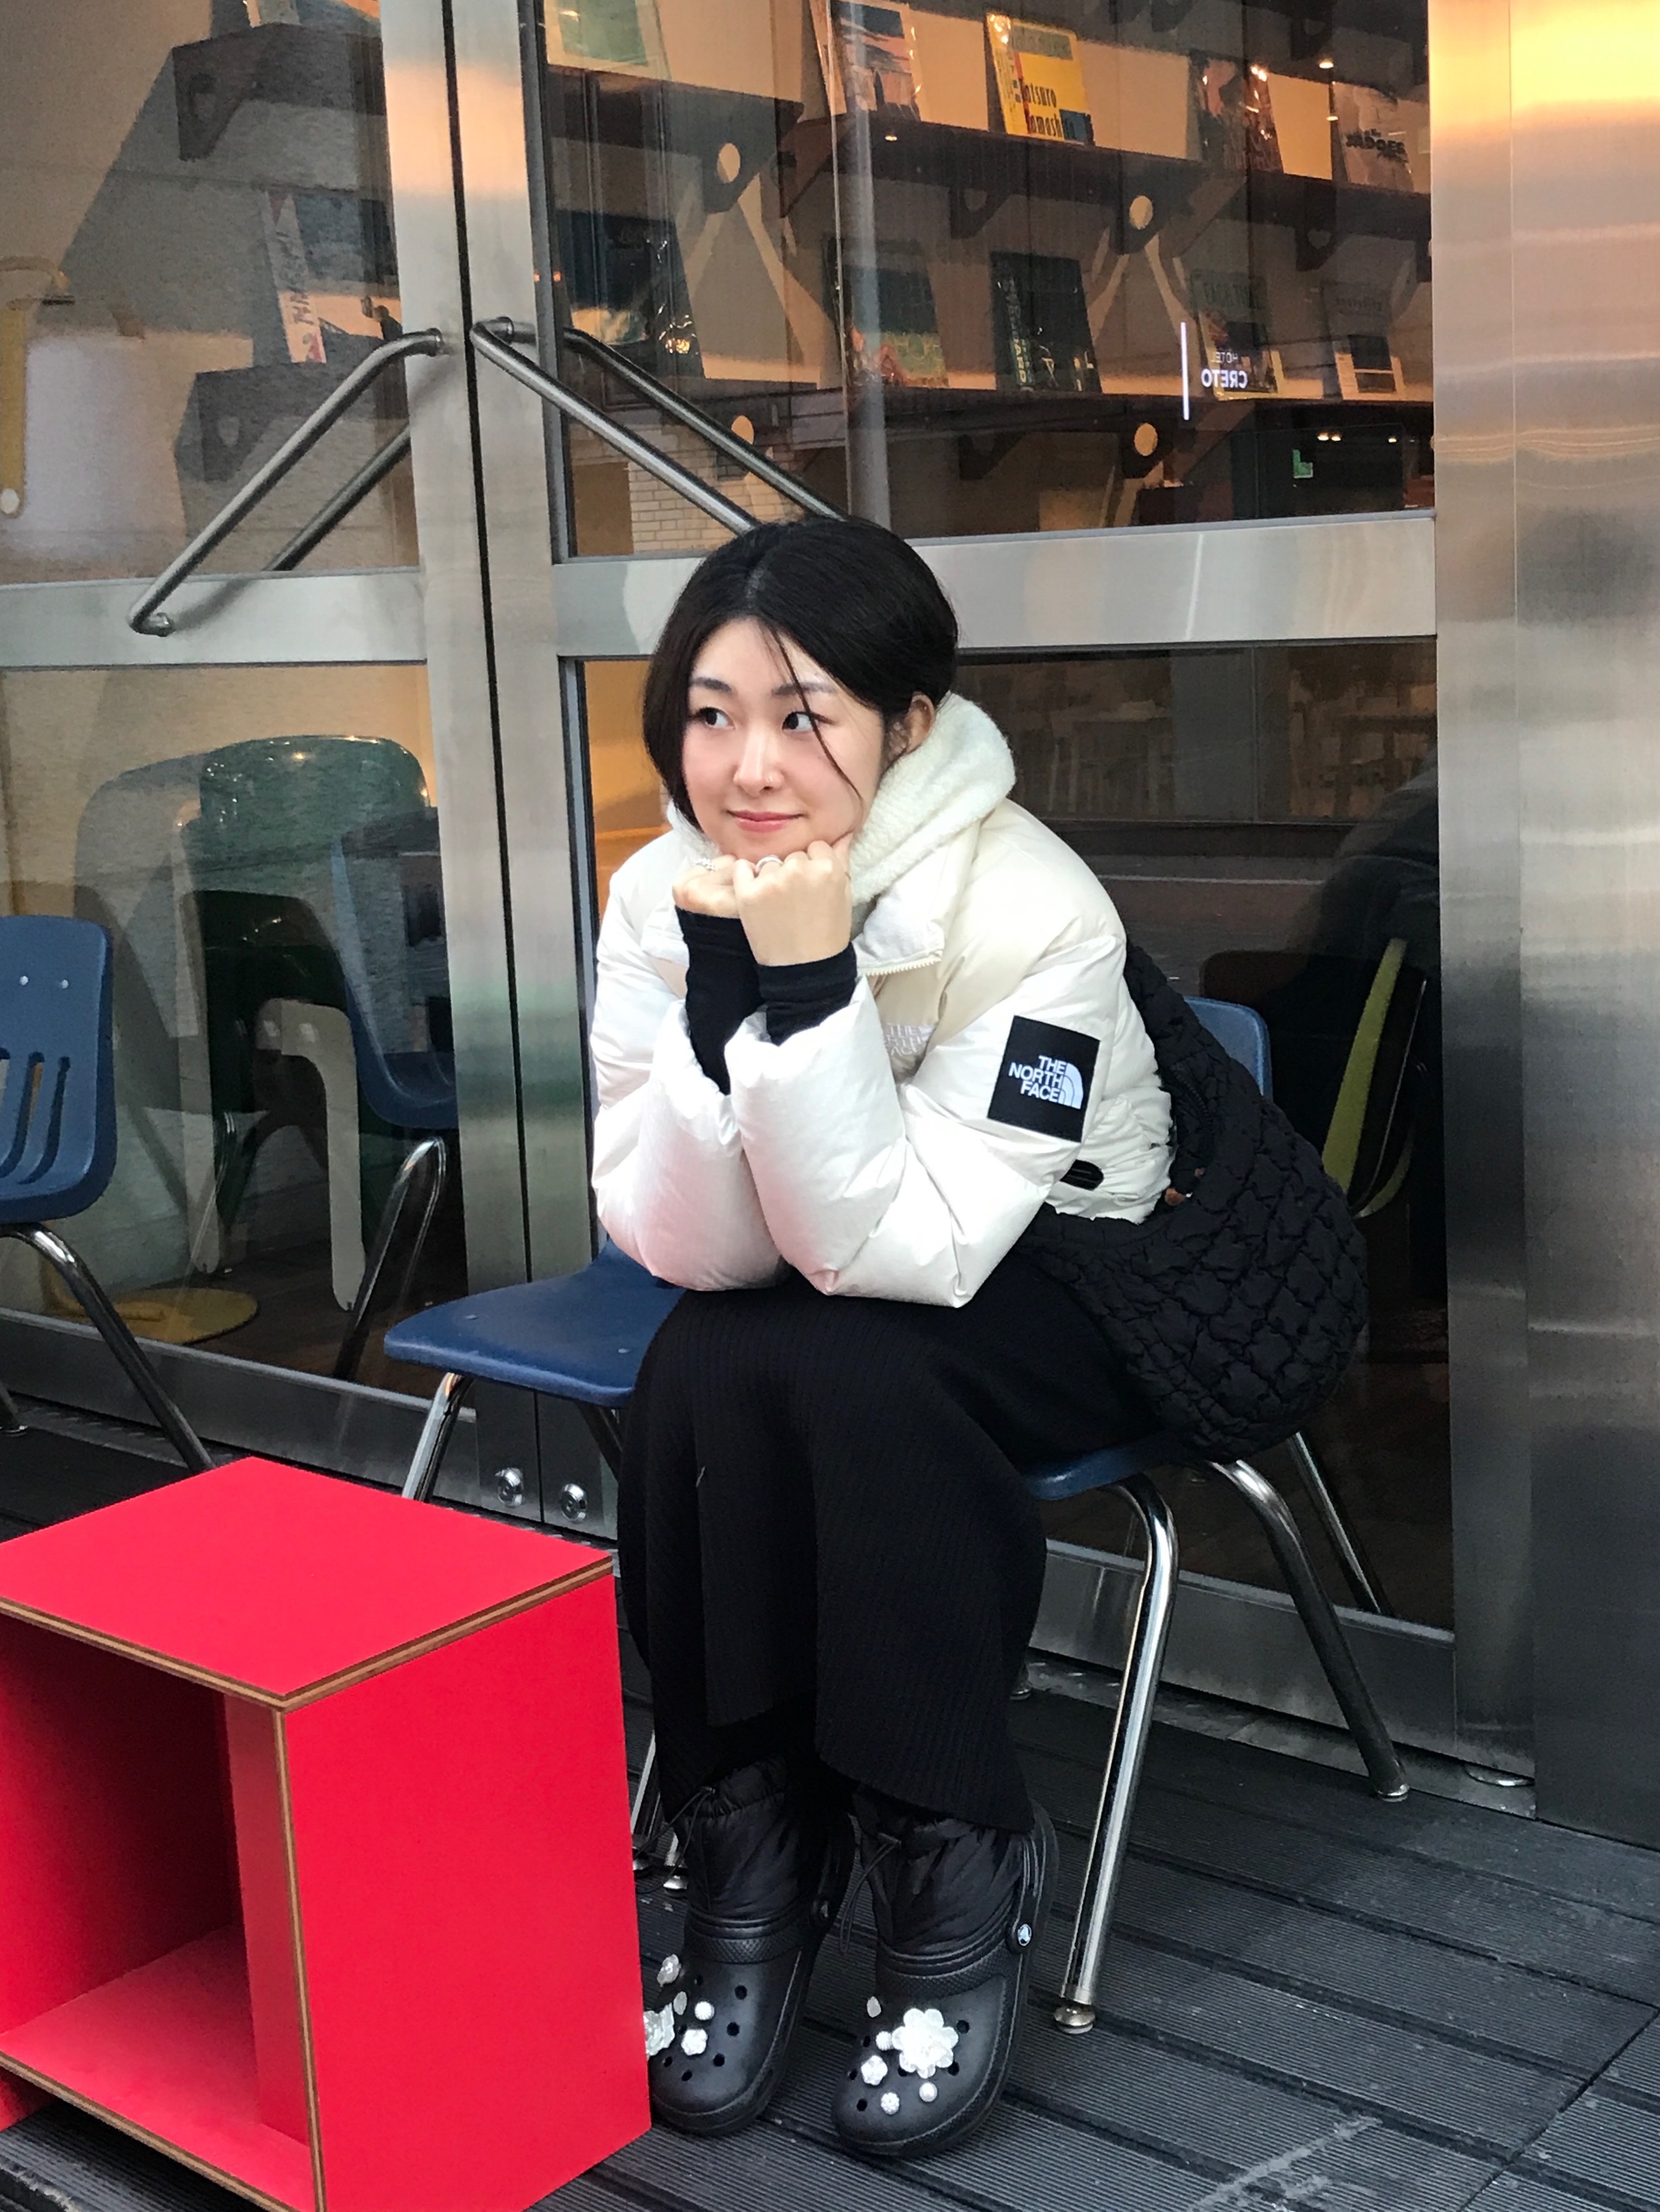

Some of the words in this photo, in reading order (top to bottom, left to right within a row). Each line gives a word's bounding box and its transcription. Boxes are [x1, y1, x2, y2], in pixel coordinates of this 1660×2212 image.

[1009, 1062, 1063, 1088] NORTH
[1038, 1055, 1067, 1075] THE
[1020, 1081, 1061, 1103] FACE
